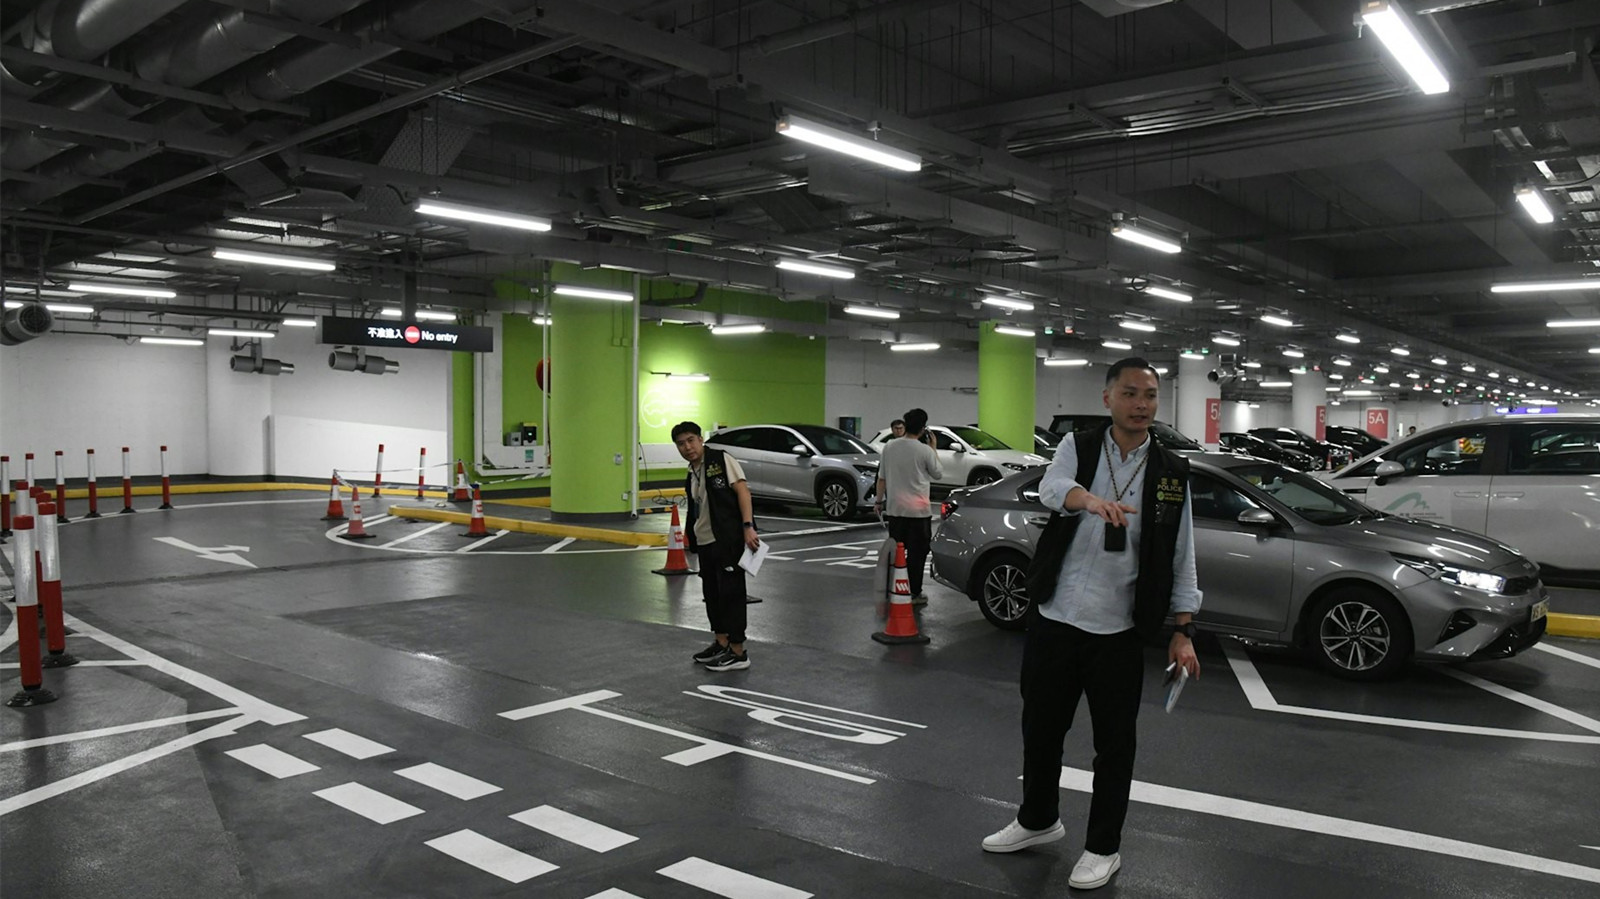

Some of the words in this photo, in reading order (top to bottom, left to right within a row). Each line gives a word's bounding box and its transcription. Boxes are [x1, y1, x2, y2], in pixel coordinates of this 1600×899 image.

[421, 330, 435, 341] No
[435, 332, 458, 344] entry
[1368, 412, 1385, 425] 5A
[1157, 484, 1182, 492] POLICE
